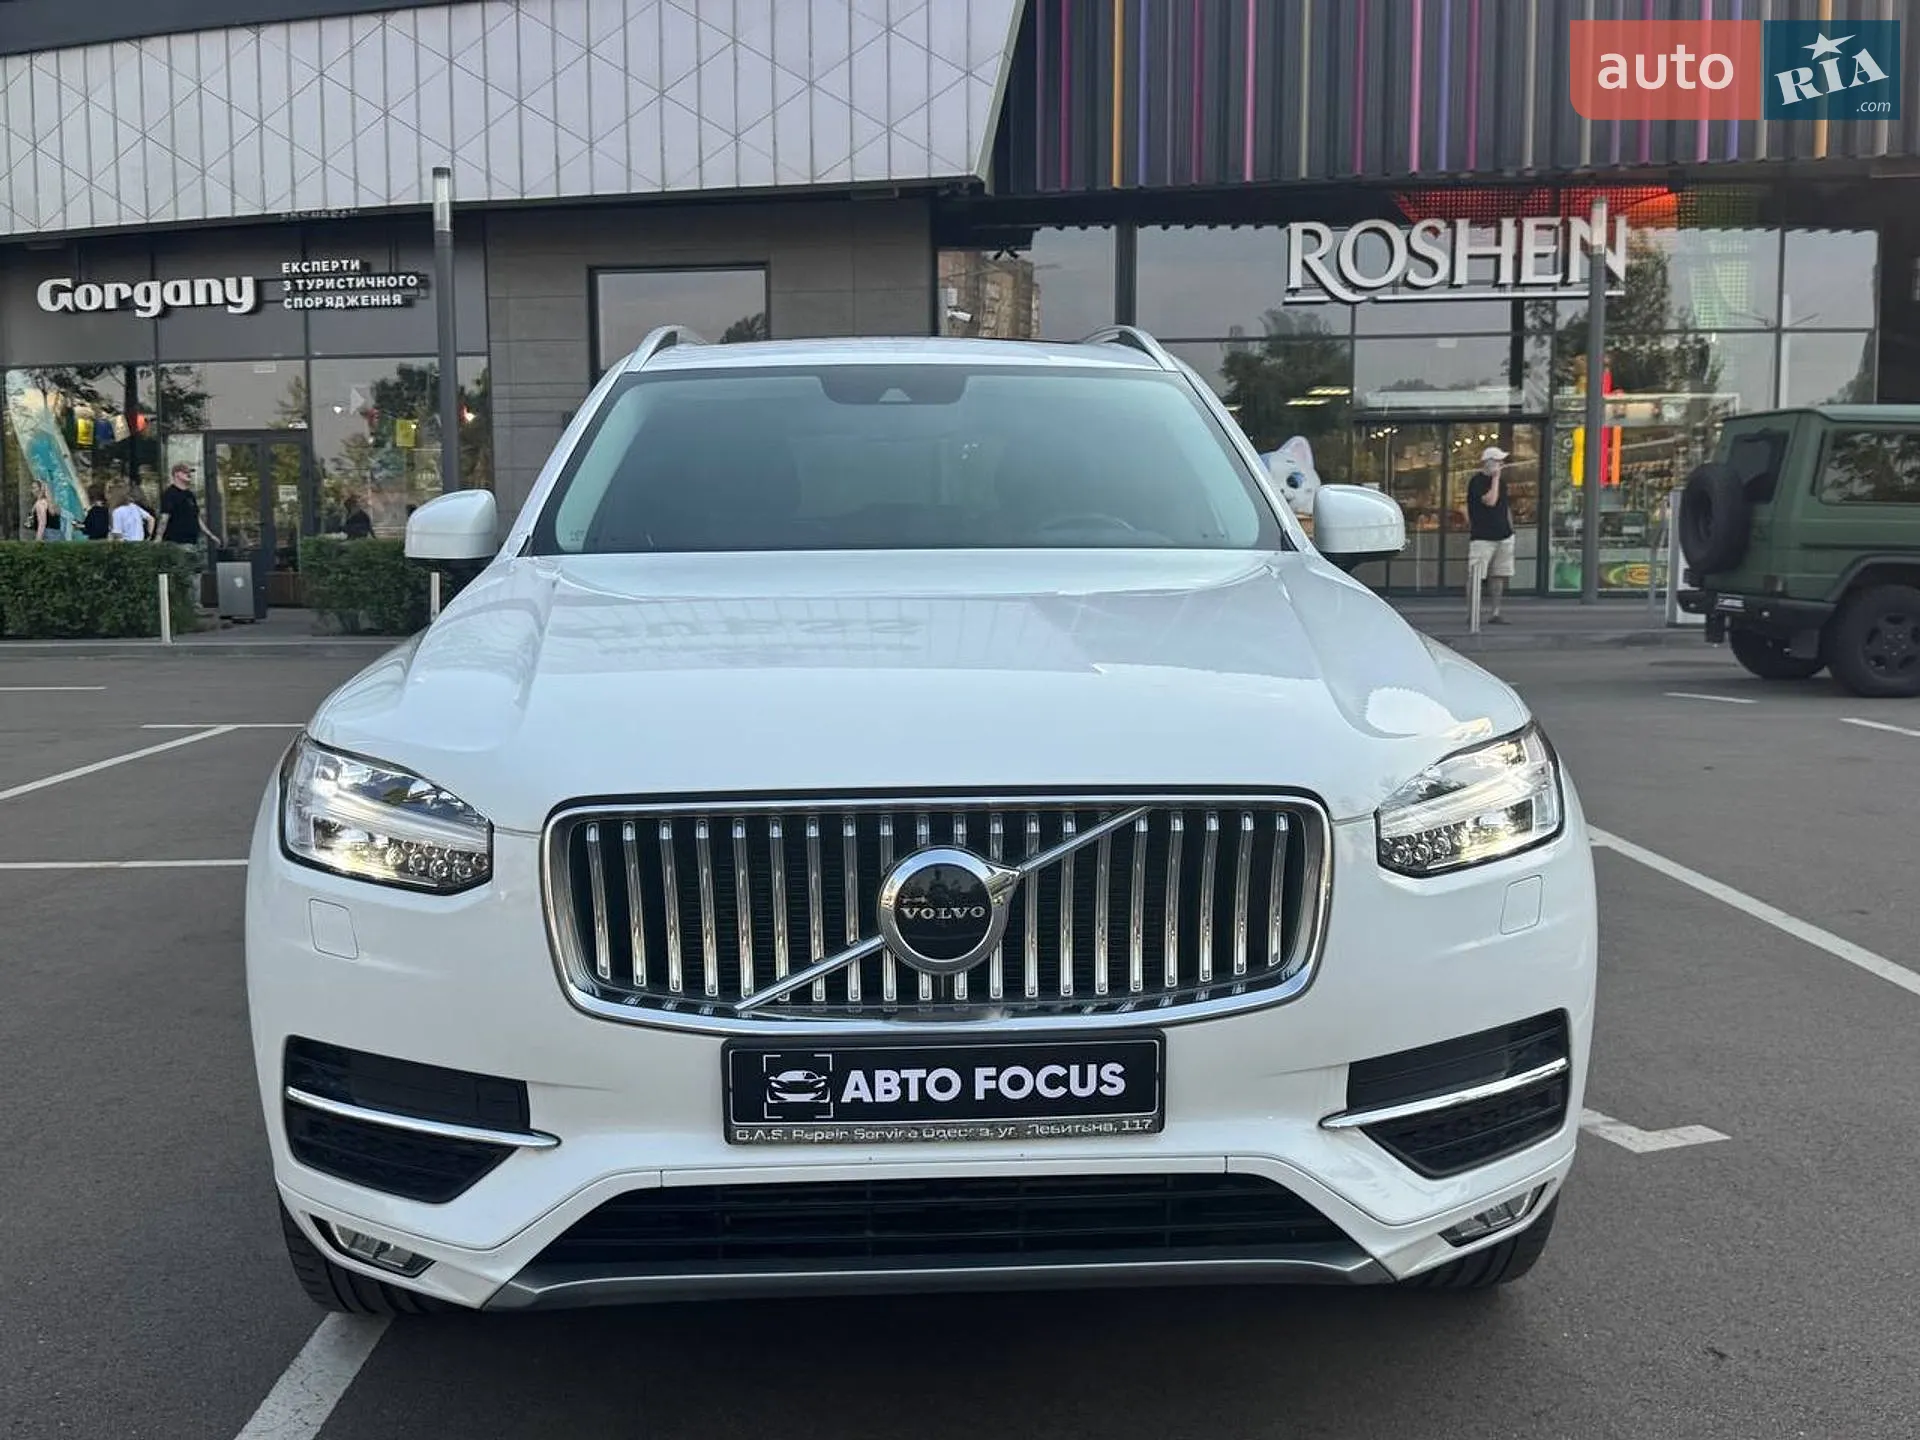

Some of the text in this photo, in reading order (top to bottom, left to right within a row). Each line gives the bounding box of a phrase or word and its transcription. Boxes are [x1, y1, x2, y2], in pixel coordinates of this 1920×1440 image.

[281, 259, 360, 273] ЕКСПЕРТИ
[1286, 216, 1627, 302] ROSHEN
[295, 275, 418, 291] ТУРИСТИЧНОГО
[37, 276, 256, 318] Gorgany
[283, 294, 402, 309] СПОРЯДЖЕННЯ
[900, 906, 986, 920] VOLVO
[975, 1062, 1126, 1101] FOCUS
[791, 1128, 849, 1143] Repair
[1121, 1119, 1153, 1131] 117
